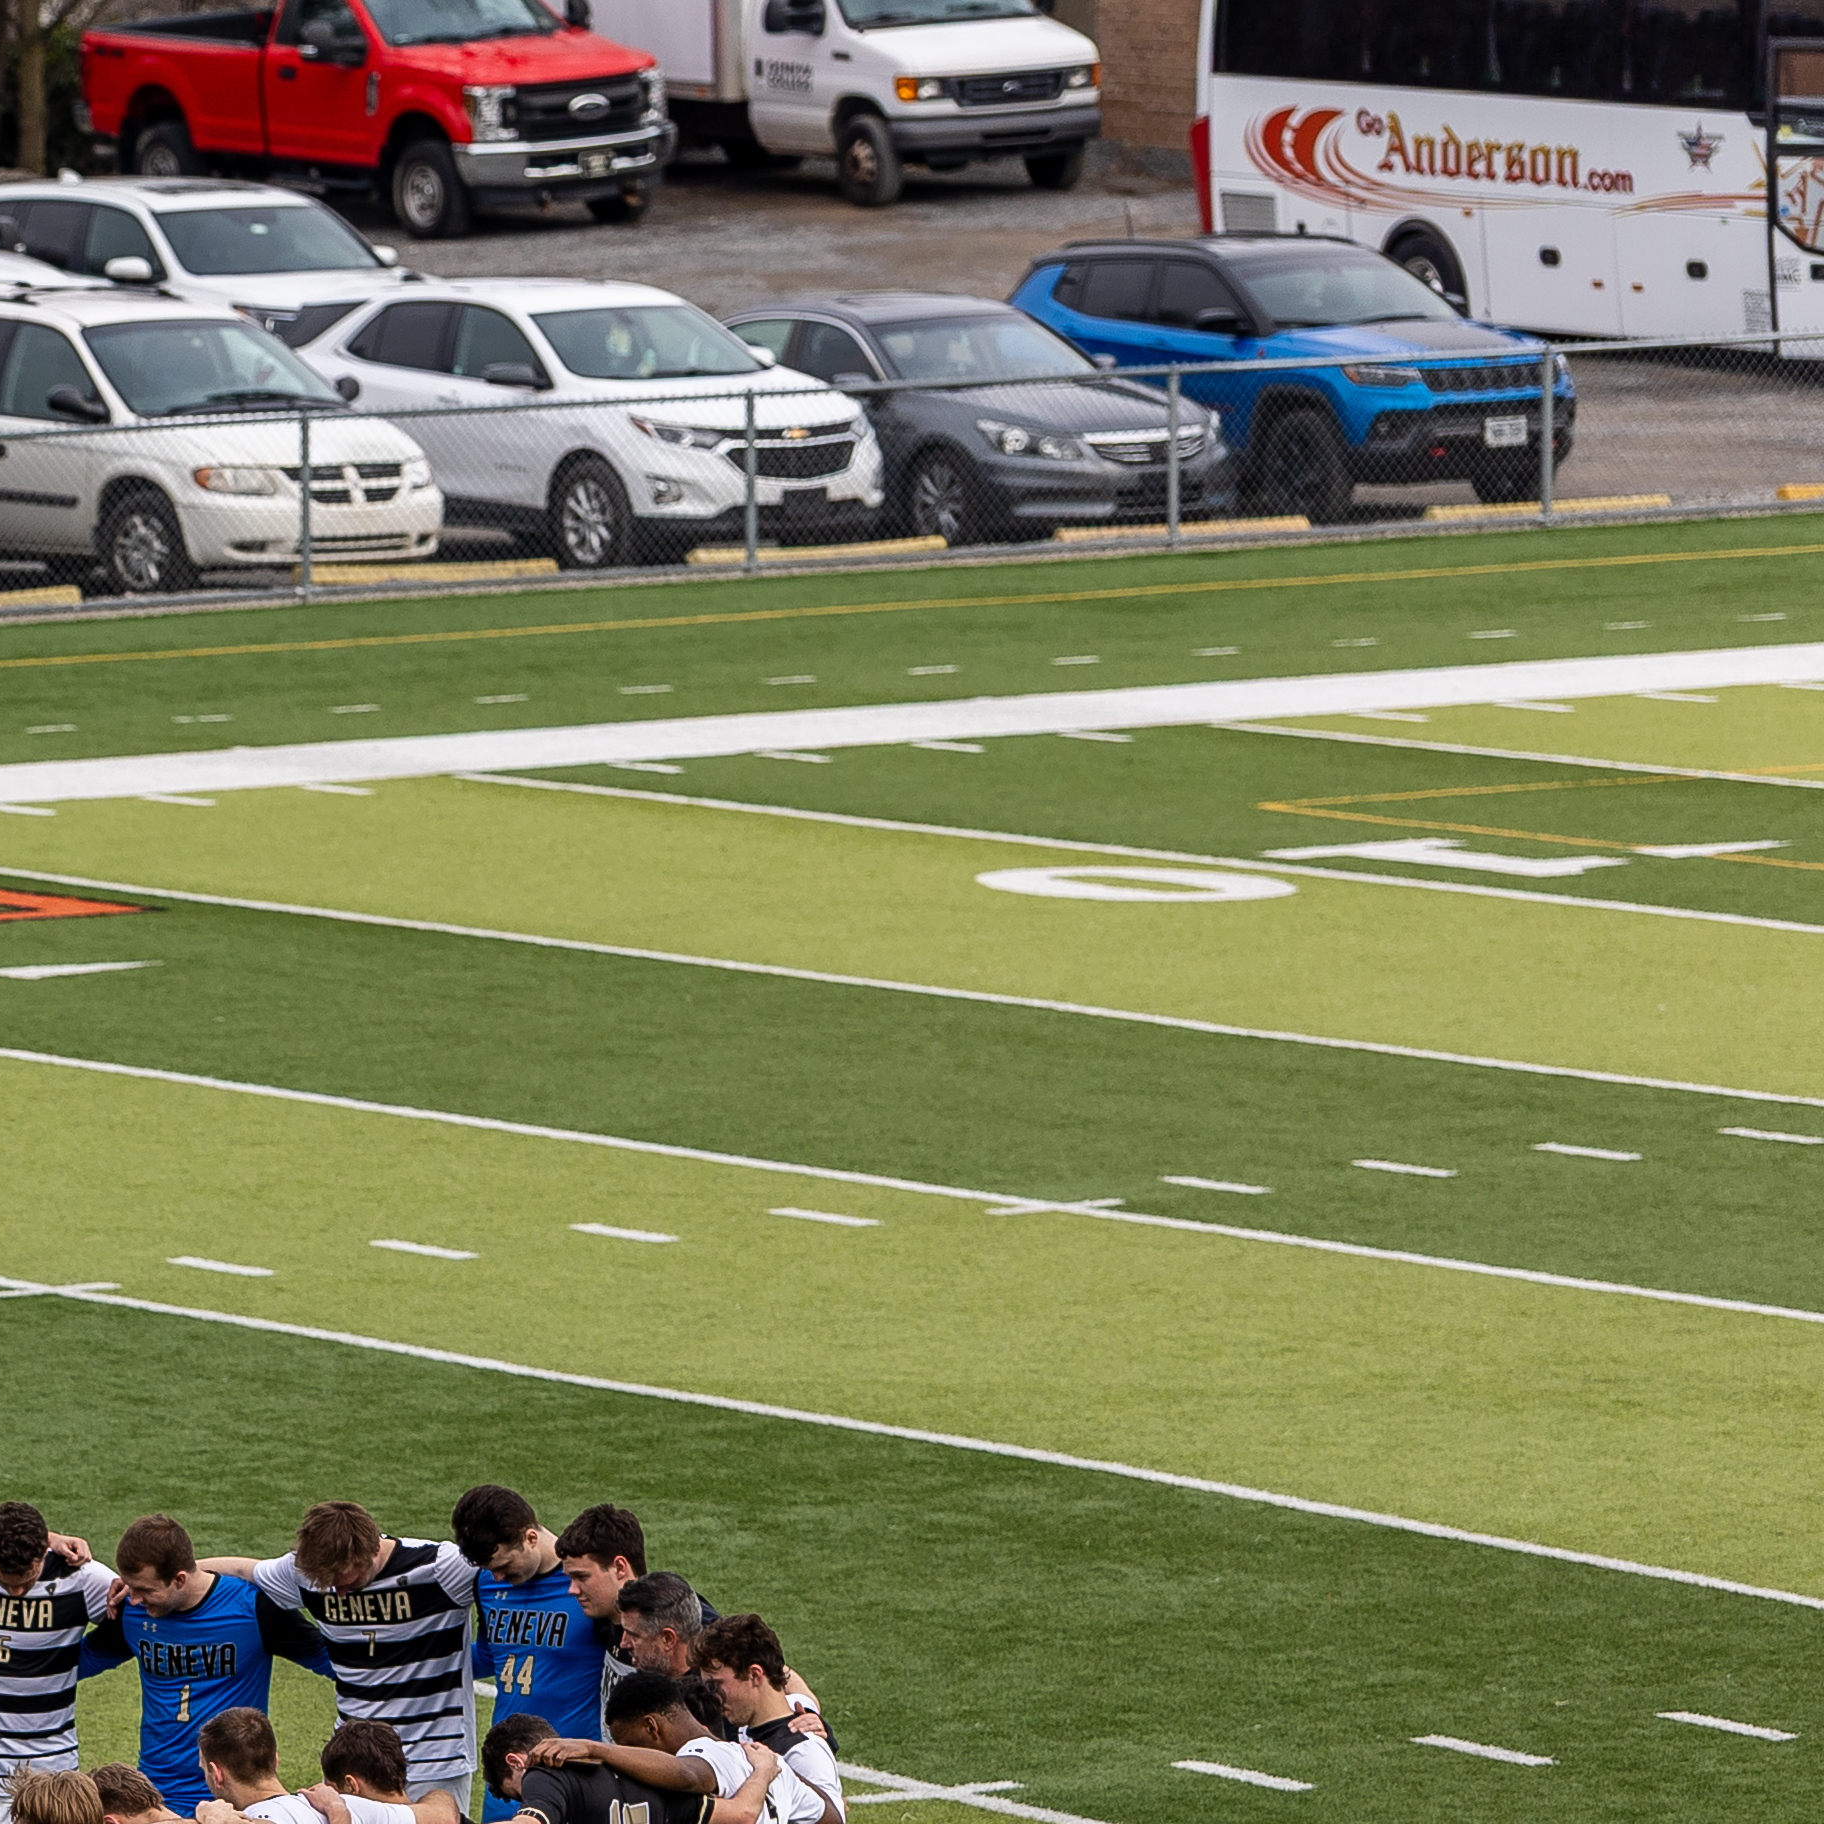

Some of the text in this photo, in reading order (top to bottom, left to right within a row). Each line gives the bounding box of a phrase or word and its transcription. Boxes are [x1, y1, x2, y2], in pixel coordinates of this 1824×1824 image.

[1355, 108, 1384, 137] Go
[324, 1590, 412, 1623] GENEVA
[487, 1597, 569, 1648] GENEVA
[138, 1638, 237, 1678] GENEVA
[361, 1631, 377, 1657] 7
[499, 1653, 535, 1696] 44
[176, 1684, 190, 1722] 1
